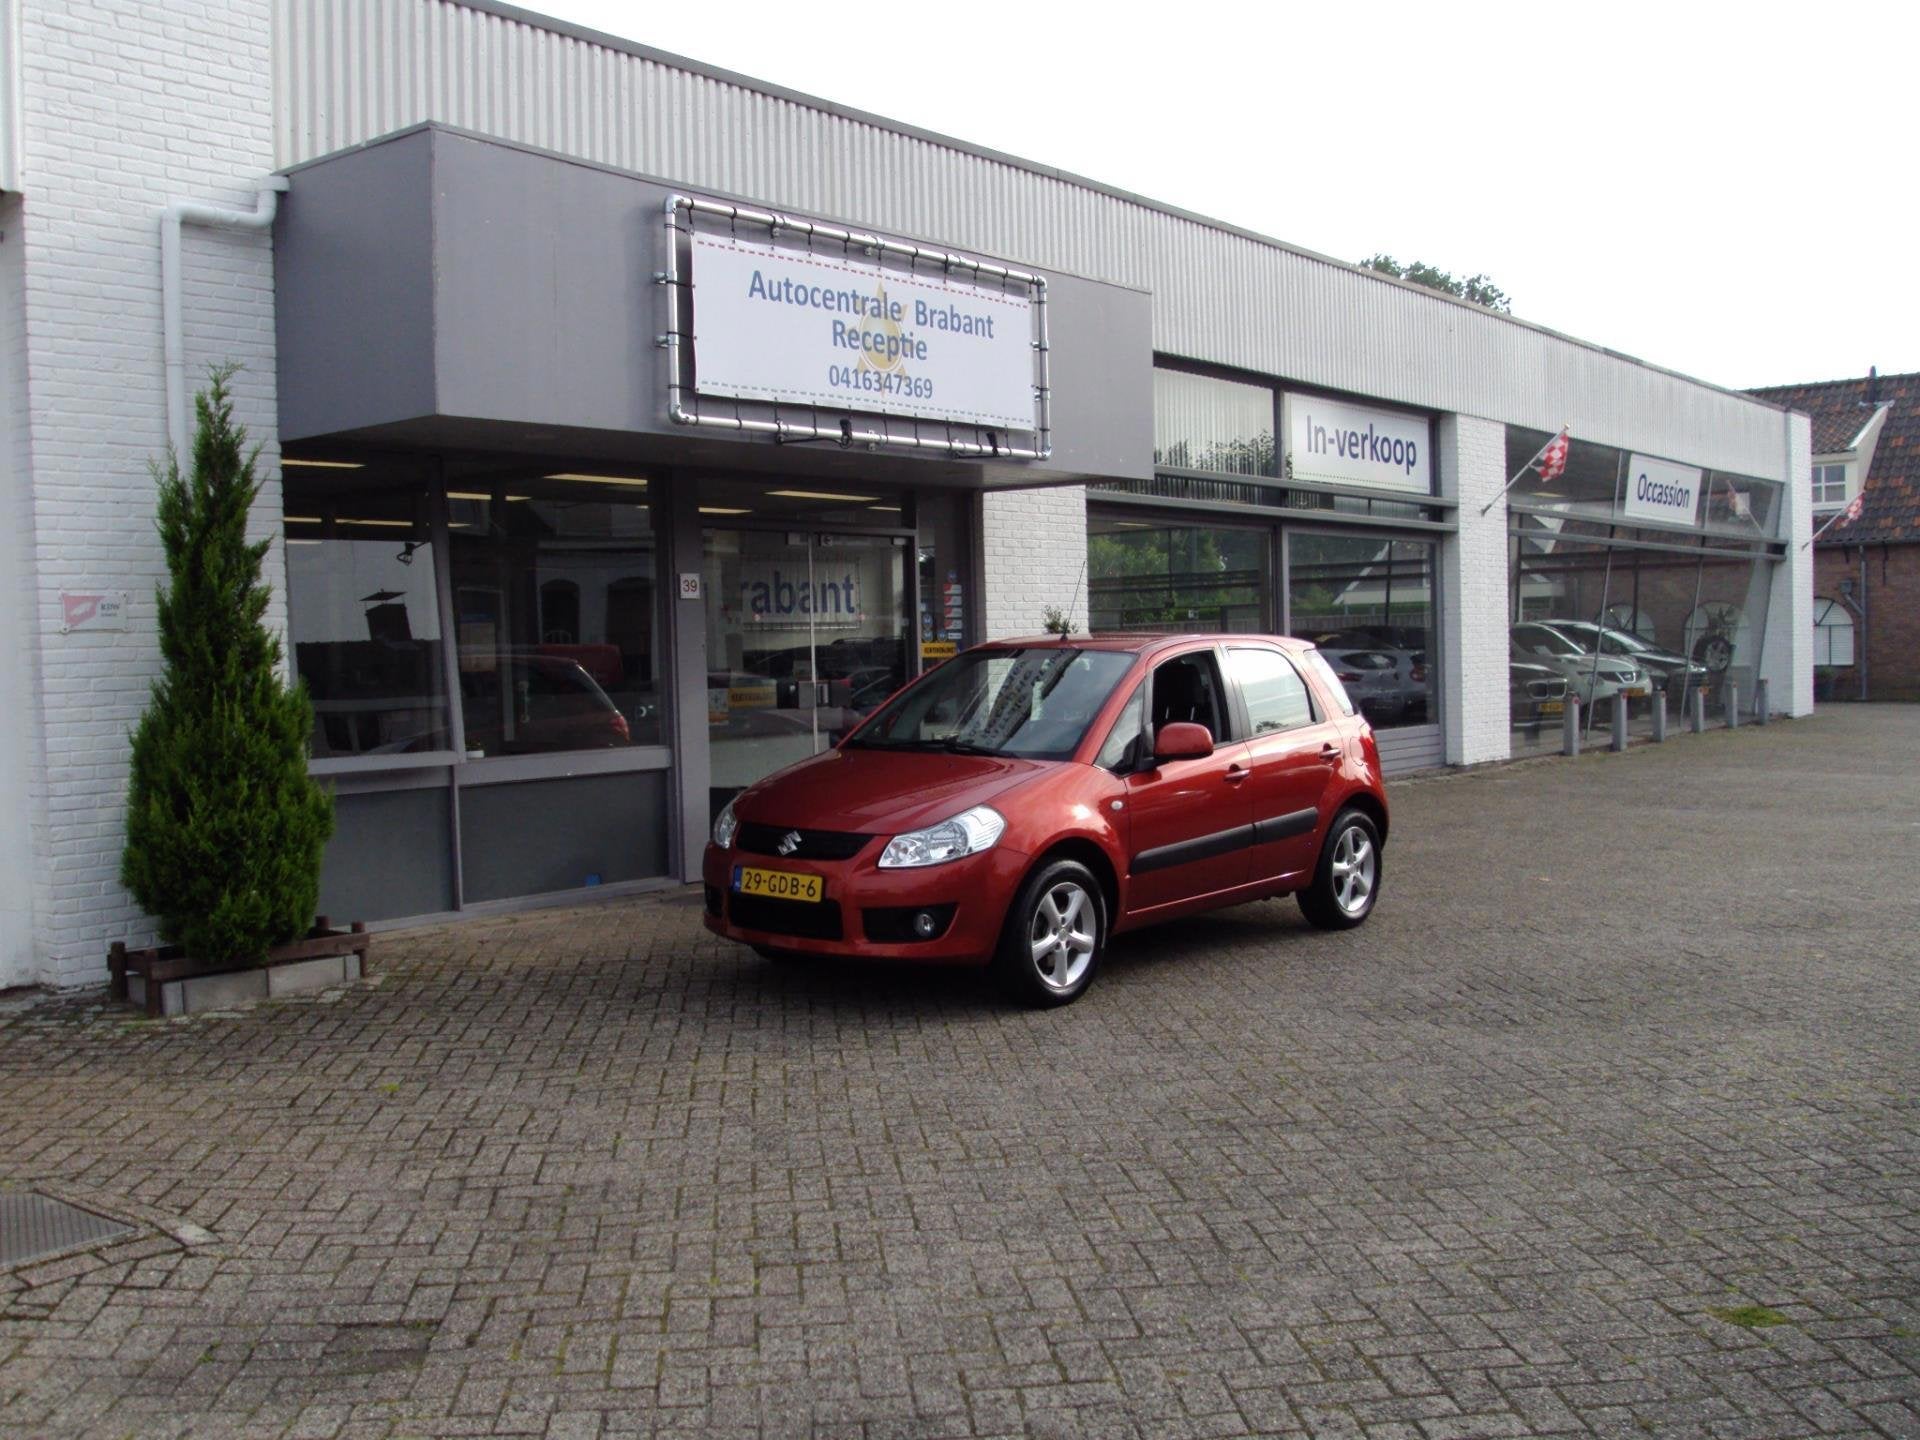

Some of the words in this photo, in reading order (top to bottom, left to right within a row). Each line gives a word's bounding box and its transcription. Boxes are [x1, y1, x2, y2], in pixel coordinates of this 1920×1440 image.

[748, 270, 902, 322] Autocentrale
[915, 299, 994, 339] Brabant
[832, 319, 928, 361] Receptie
[829, 365, 933, 399] 0416347369
[1306, 414, 1417, 476] In-verkoop
[1637, 473, 1690, 509] Occassion
[682, 579, 697, 593] 39
[744, 871, 816, 897] 29-GDB-6
